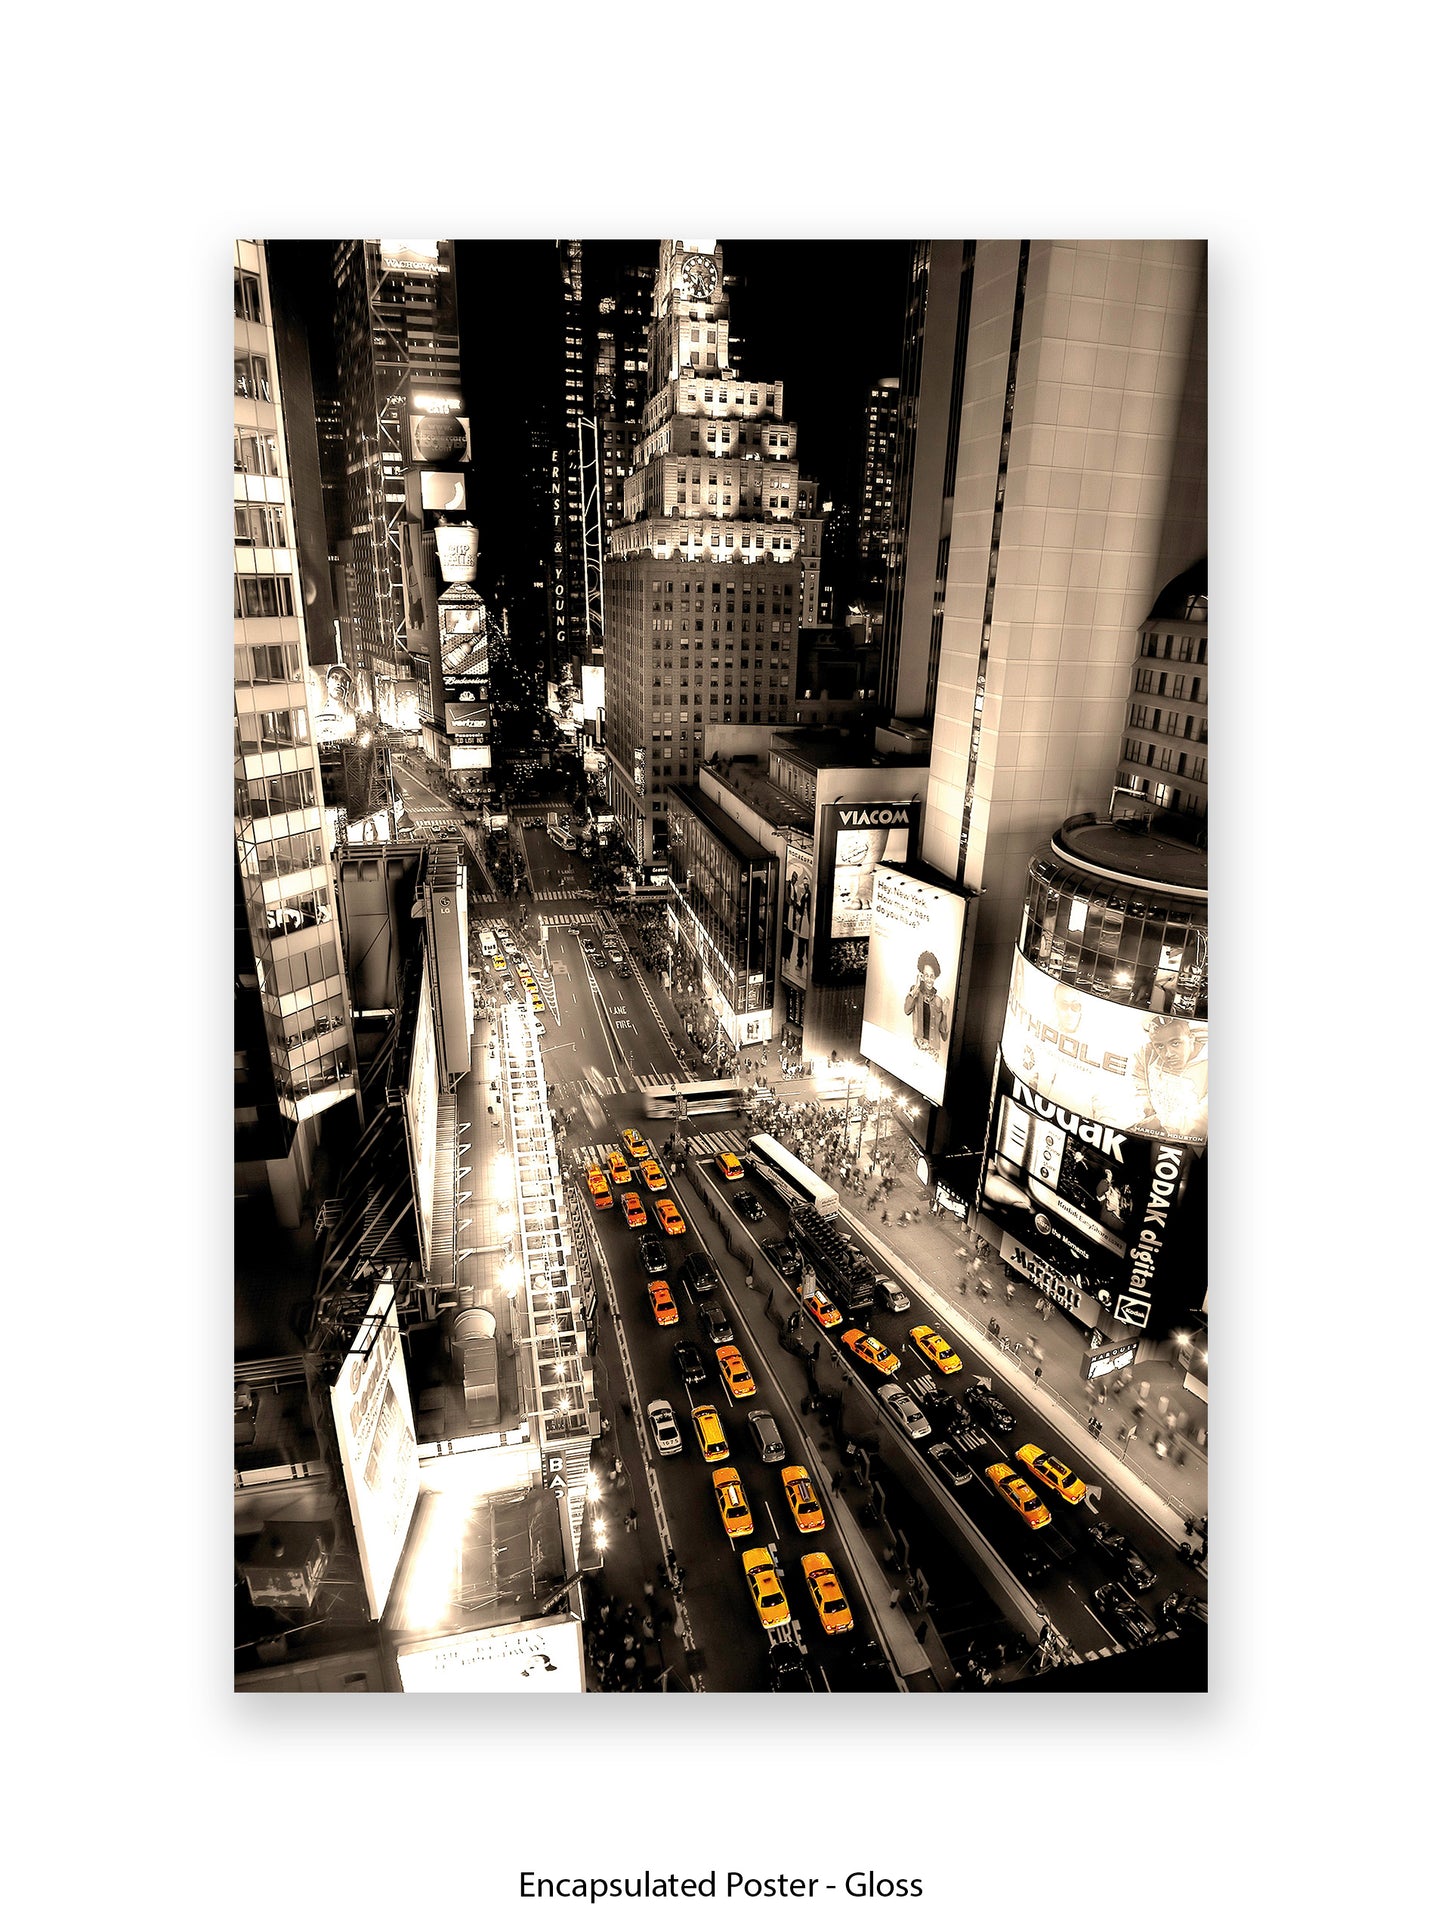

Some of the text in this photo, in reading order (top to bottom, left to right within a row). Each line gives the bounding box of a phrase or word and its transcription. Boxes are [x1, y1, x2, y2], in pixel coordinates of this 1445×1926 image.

[552, 450, 566, 642] ERNST & YOUNG
[839, 809, 910, 825] VIACOM
[877, 892, 893, 905] How
[876, 905, 886, 914] do
[609, 1005, 627, 1015] LANE
[615, 1020, 632, 1029] FIRE
[1128, 1145, 1184, 1298] KODAK digital
[1010, 1247, 1082, 1309] Marriott
[1125, 1307, 1145, 1319] Kodak
[1091, 1343, 1138, 1362] MARQUIS
